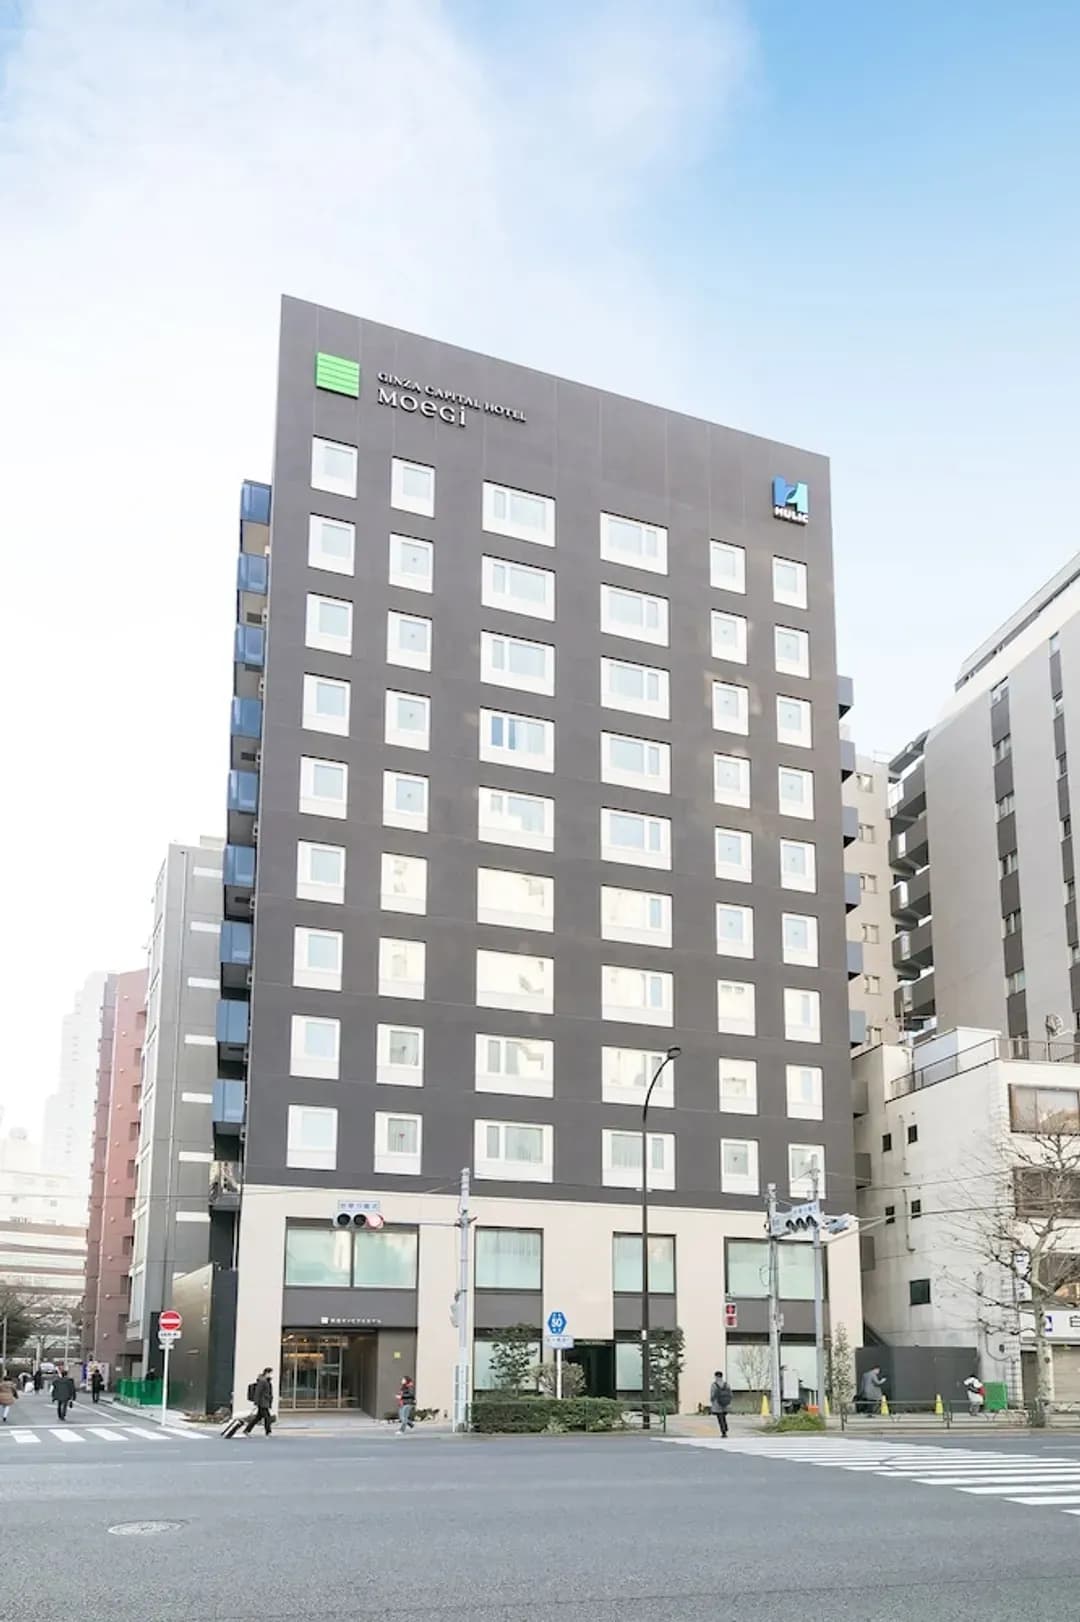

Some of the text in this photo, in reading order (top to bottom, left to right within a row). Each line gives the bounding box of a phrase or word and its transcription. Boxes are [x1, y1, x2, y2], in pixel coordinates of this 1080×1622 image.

[377, 372, 527, 422] GINZA CAPITAL HOTEL
[774, 506, 808, 524] HULIC
